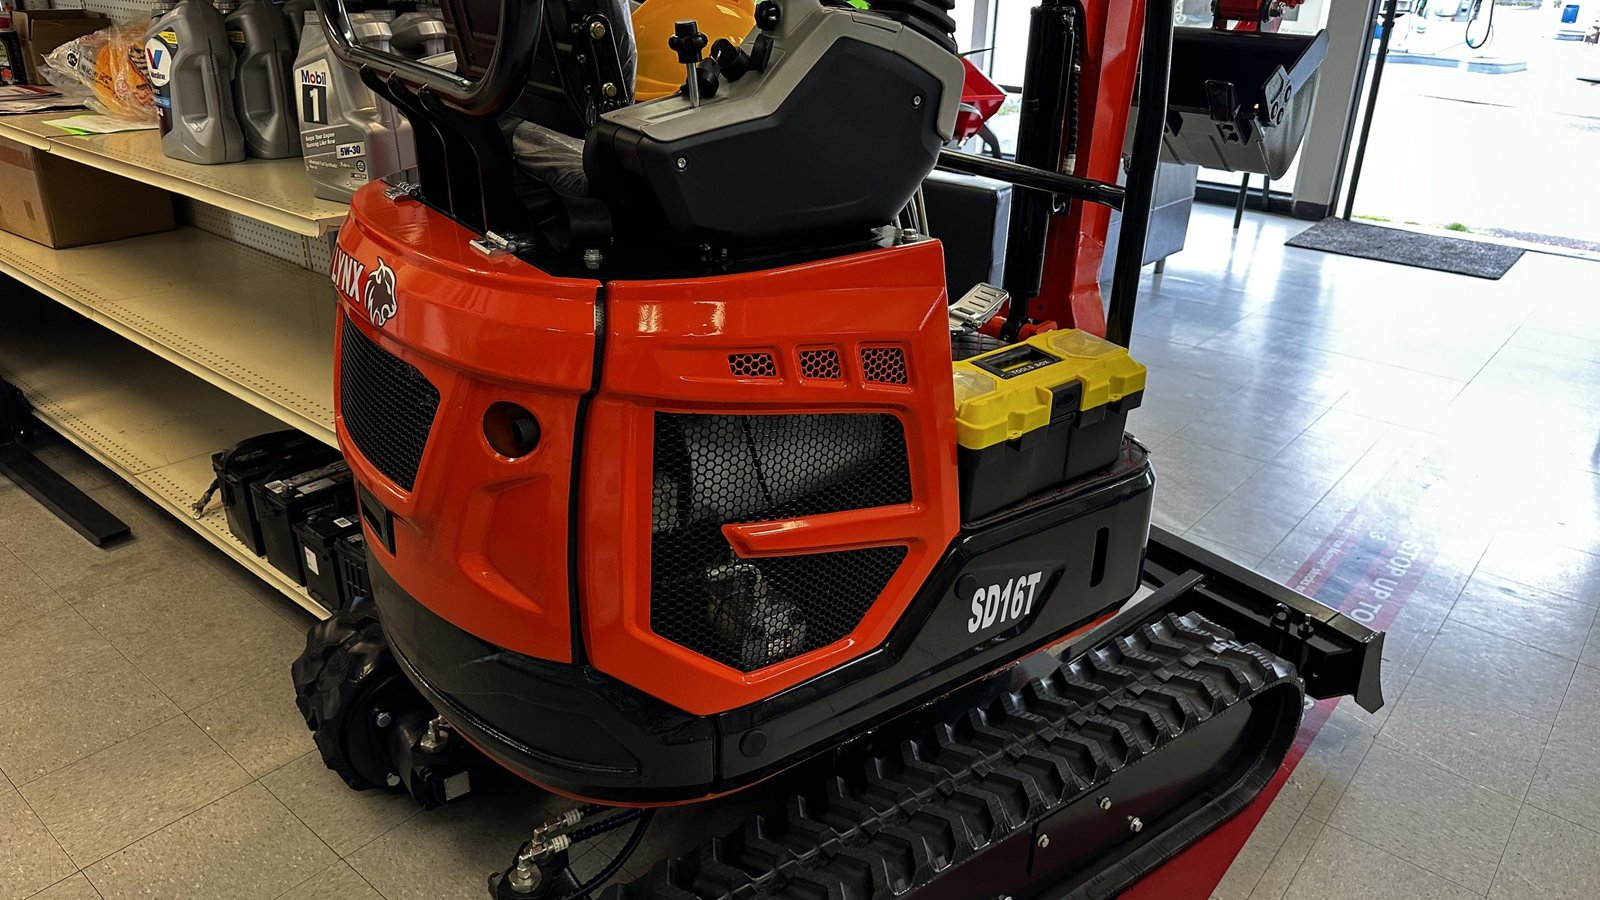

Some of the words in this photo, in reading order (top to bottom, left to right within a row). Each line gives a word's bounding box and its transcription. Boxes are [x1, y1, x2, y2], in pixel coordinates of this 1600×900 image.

[301, 70, 327, 85] Mobil
[309, 88, 320, 122] 1
[340, 145, 361, 157] 5W-30
[331, 246, 364, 302] LYNX
[1385, 541, 1423, 578] STOP
[967, 571, 1042, 633] SD16T
[1369, 577, 1398, 600] UP
[1350, 601, 1383, 623] TO
